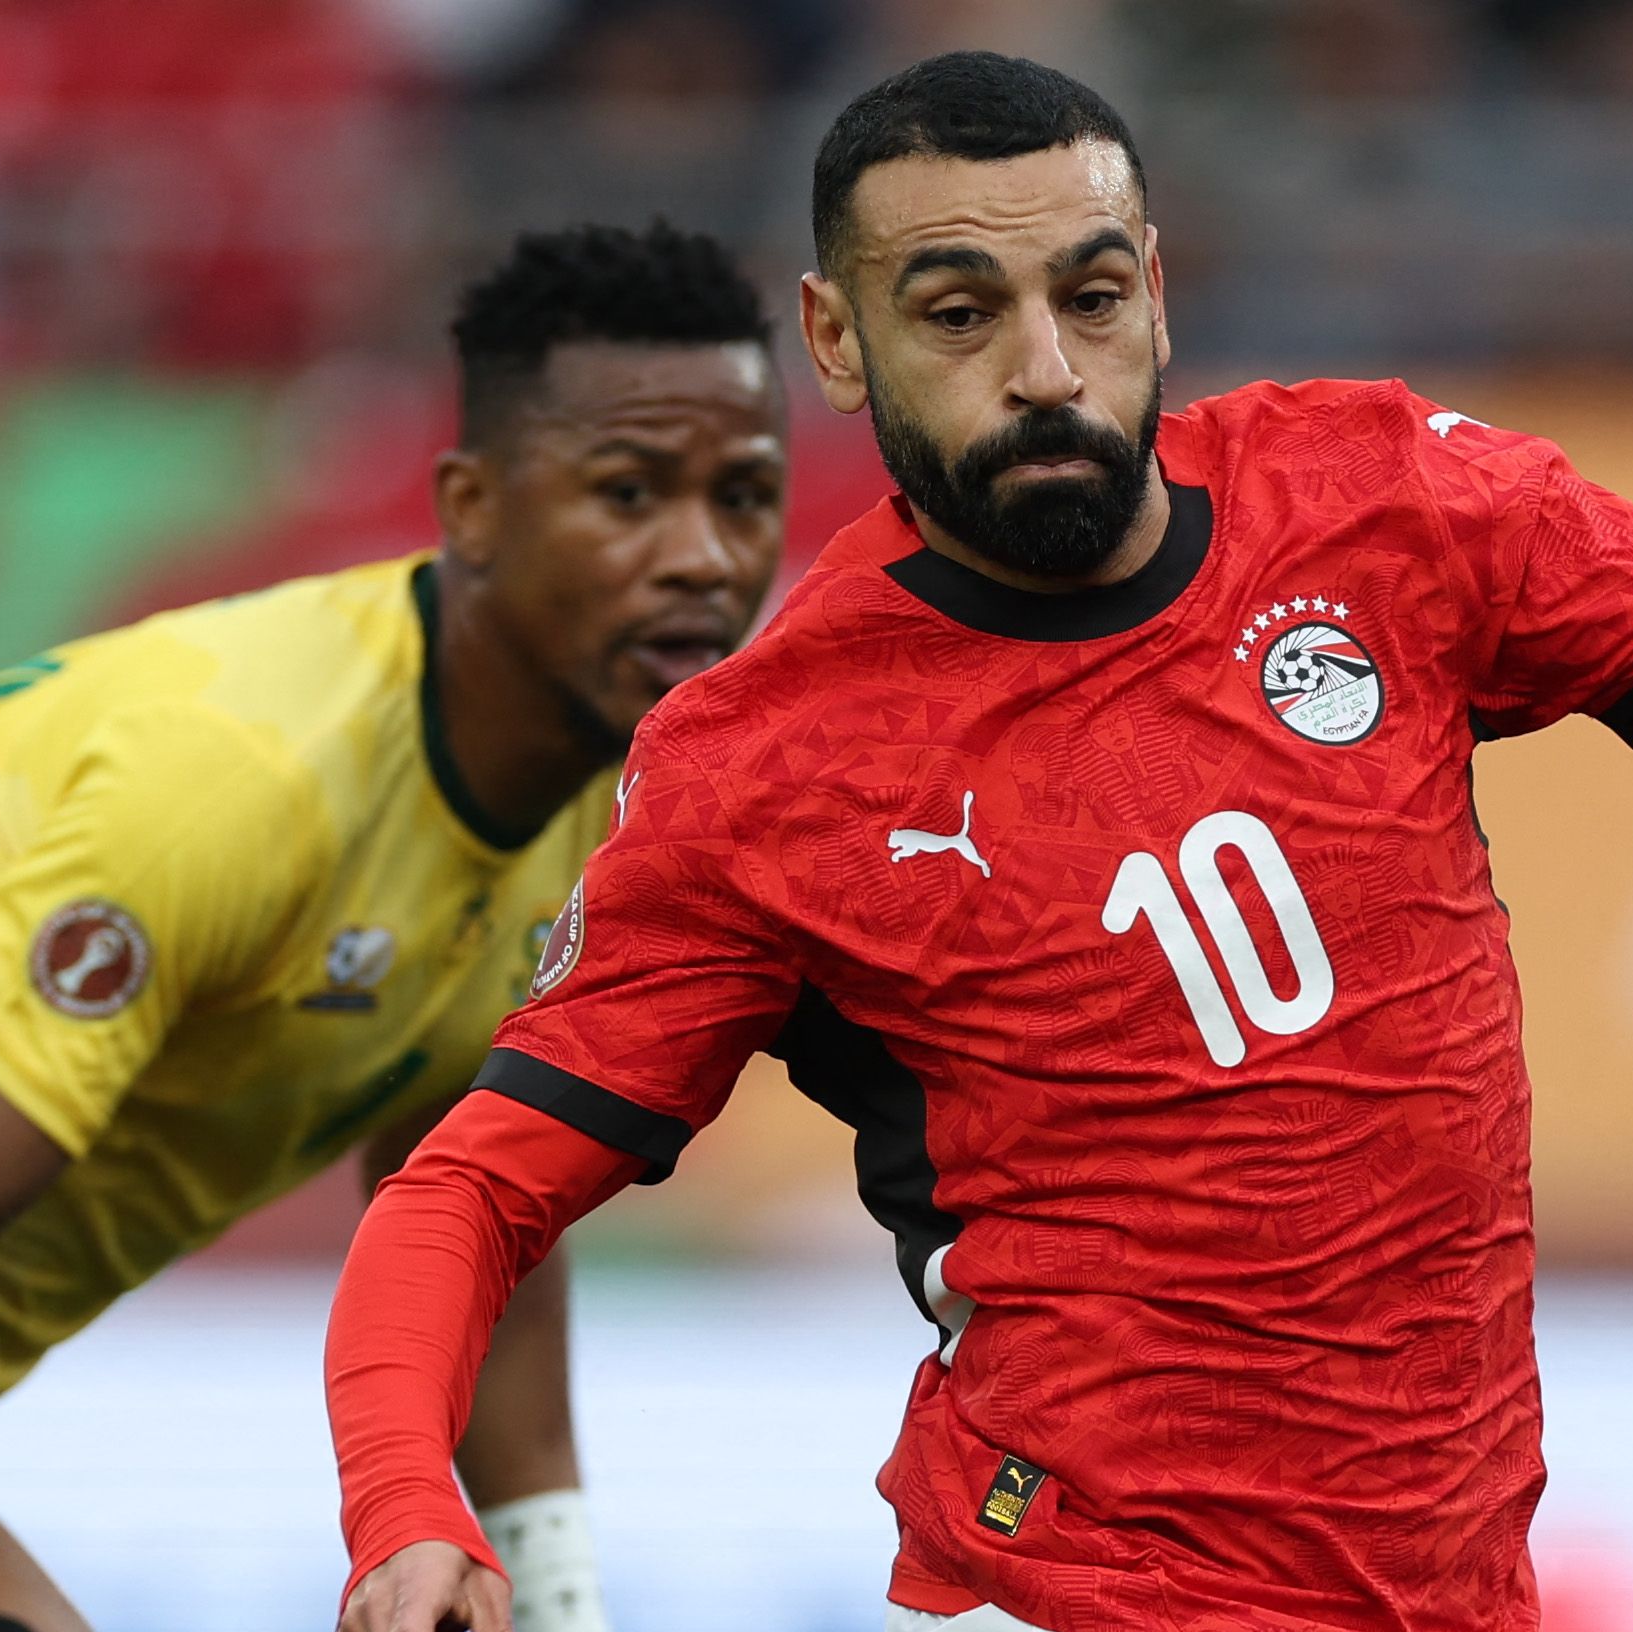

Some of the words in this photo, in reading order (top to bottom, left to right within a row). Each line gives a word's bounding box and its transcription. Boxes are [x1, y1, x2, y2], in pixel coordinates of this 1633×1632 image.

[1323, 719, 1362, 735] EGYPTIAN
[1358, 709, 1369, 720] FA
[568, 914, 579, 942] CUP
[1101, 810, 1334, 1068] 10
[560, 944, 573, 965] OF
